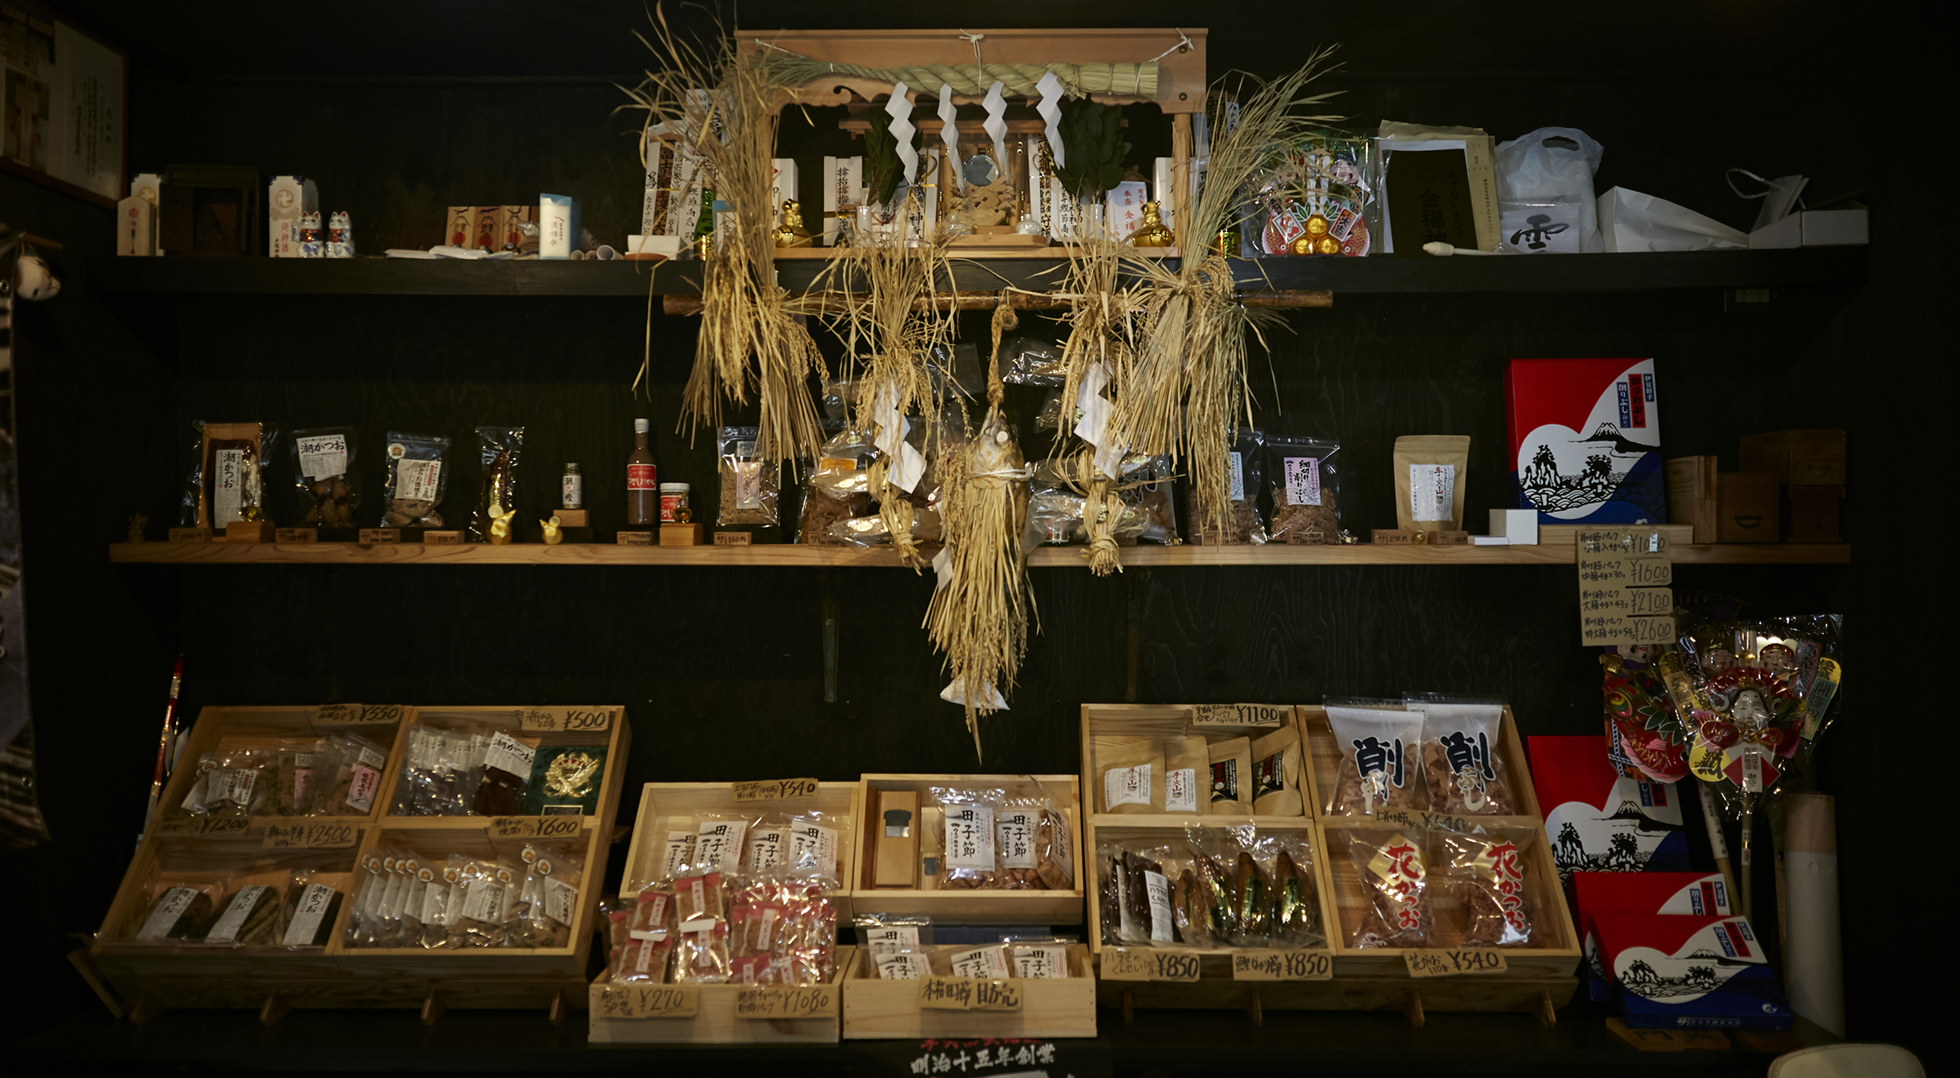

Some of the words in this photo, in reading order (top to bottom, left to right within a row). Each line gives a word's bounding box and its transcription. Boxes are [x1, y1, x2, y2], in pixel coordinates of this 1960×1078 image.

[1419, 190, 1448, 243] 金福神
[1645, 375, 1653, 400] 伊豆田子
[1631, 377, 1644, 425] かつおぶし
[300, 441, 345, 454] 潮かつお
[223, 452, 236, 489] 潮かつお
[1434, 467, 1444, 495] 手火山
[1631, 590, 1669, 614] ¥2100
[360, 707, 399, 722] ¥550
[563, 711, 606, 729] ¥500
[1236, 705, 1278, 724] ¥1100
[779, 780, 816, 798] ¥540
[1127, 768, 1137, 786] 手火山
[1171, 771, 1183, 792] 手火山
[200, 818, 249, 834] ¥1200
[306, 825, 352, 844] ¥2500
[536, 818, 578, 836] ¥600
[961, 810, 975, 858] 田子節
[1013, 815, 1027, 858] 田子節
[708, 825, 728, 867] 田子節
[1385, 842, 1422, 929] 花かつお
[1487, 841, 1526, 929] 花かつお
[163, 888, 190, 913] 潮かつお
[306, 885, 327, 914] 潮かつお
[1155, 953, 1199, 977] ¥850
[1285, 953, 1329, 976] ¥850
[1447, 951, 1500, 972] ¥540
[639, 989, 684, 1013] ¥270
[783, 989, 830, 1014] ¥1080
[911, 1043, 1057, 1076] 明治十五年創業
